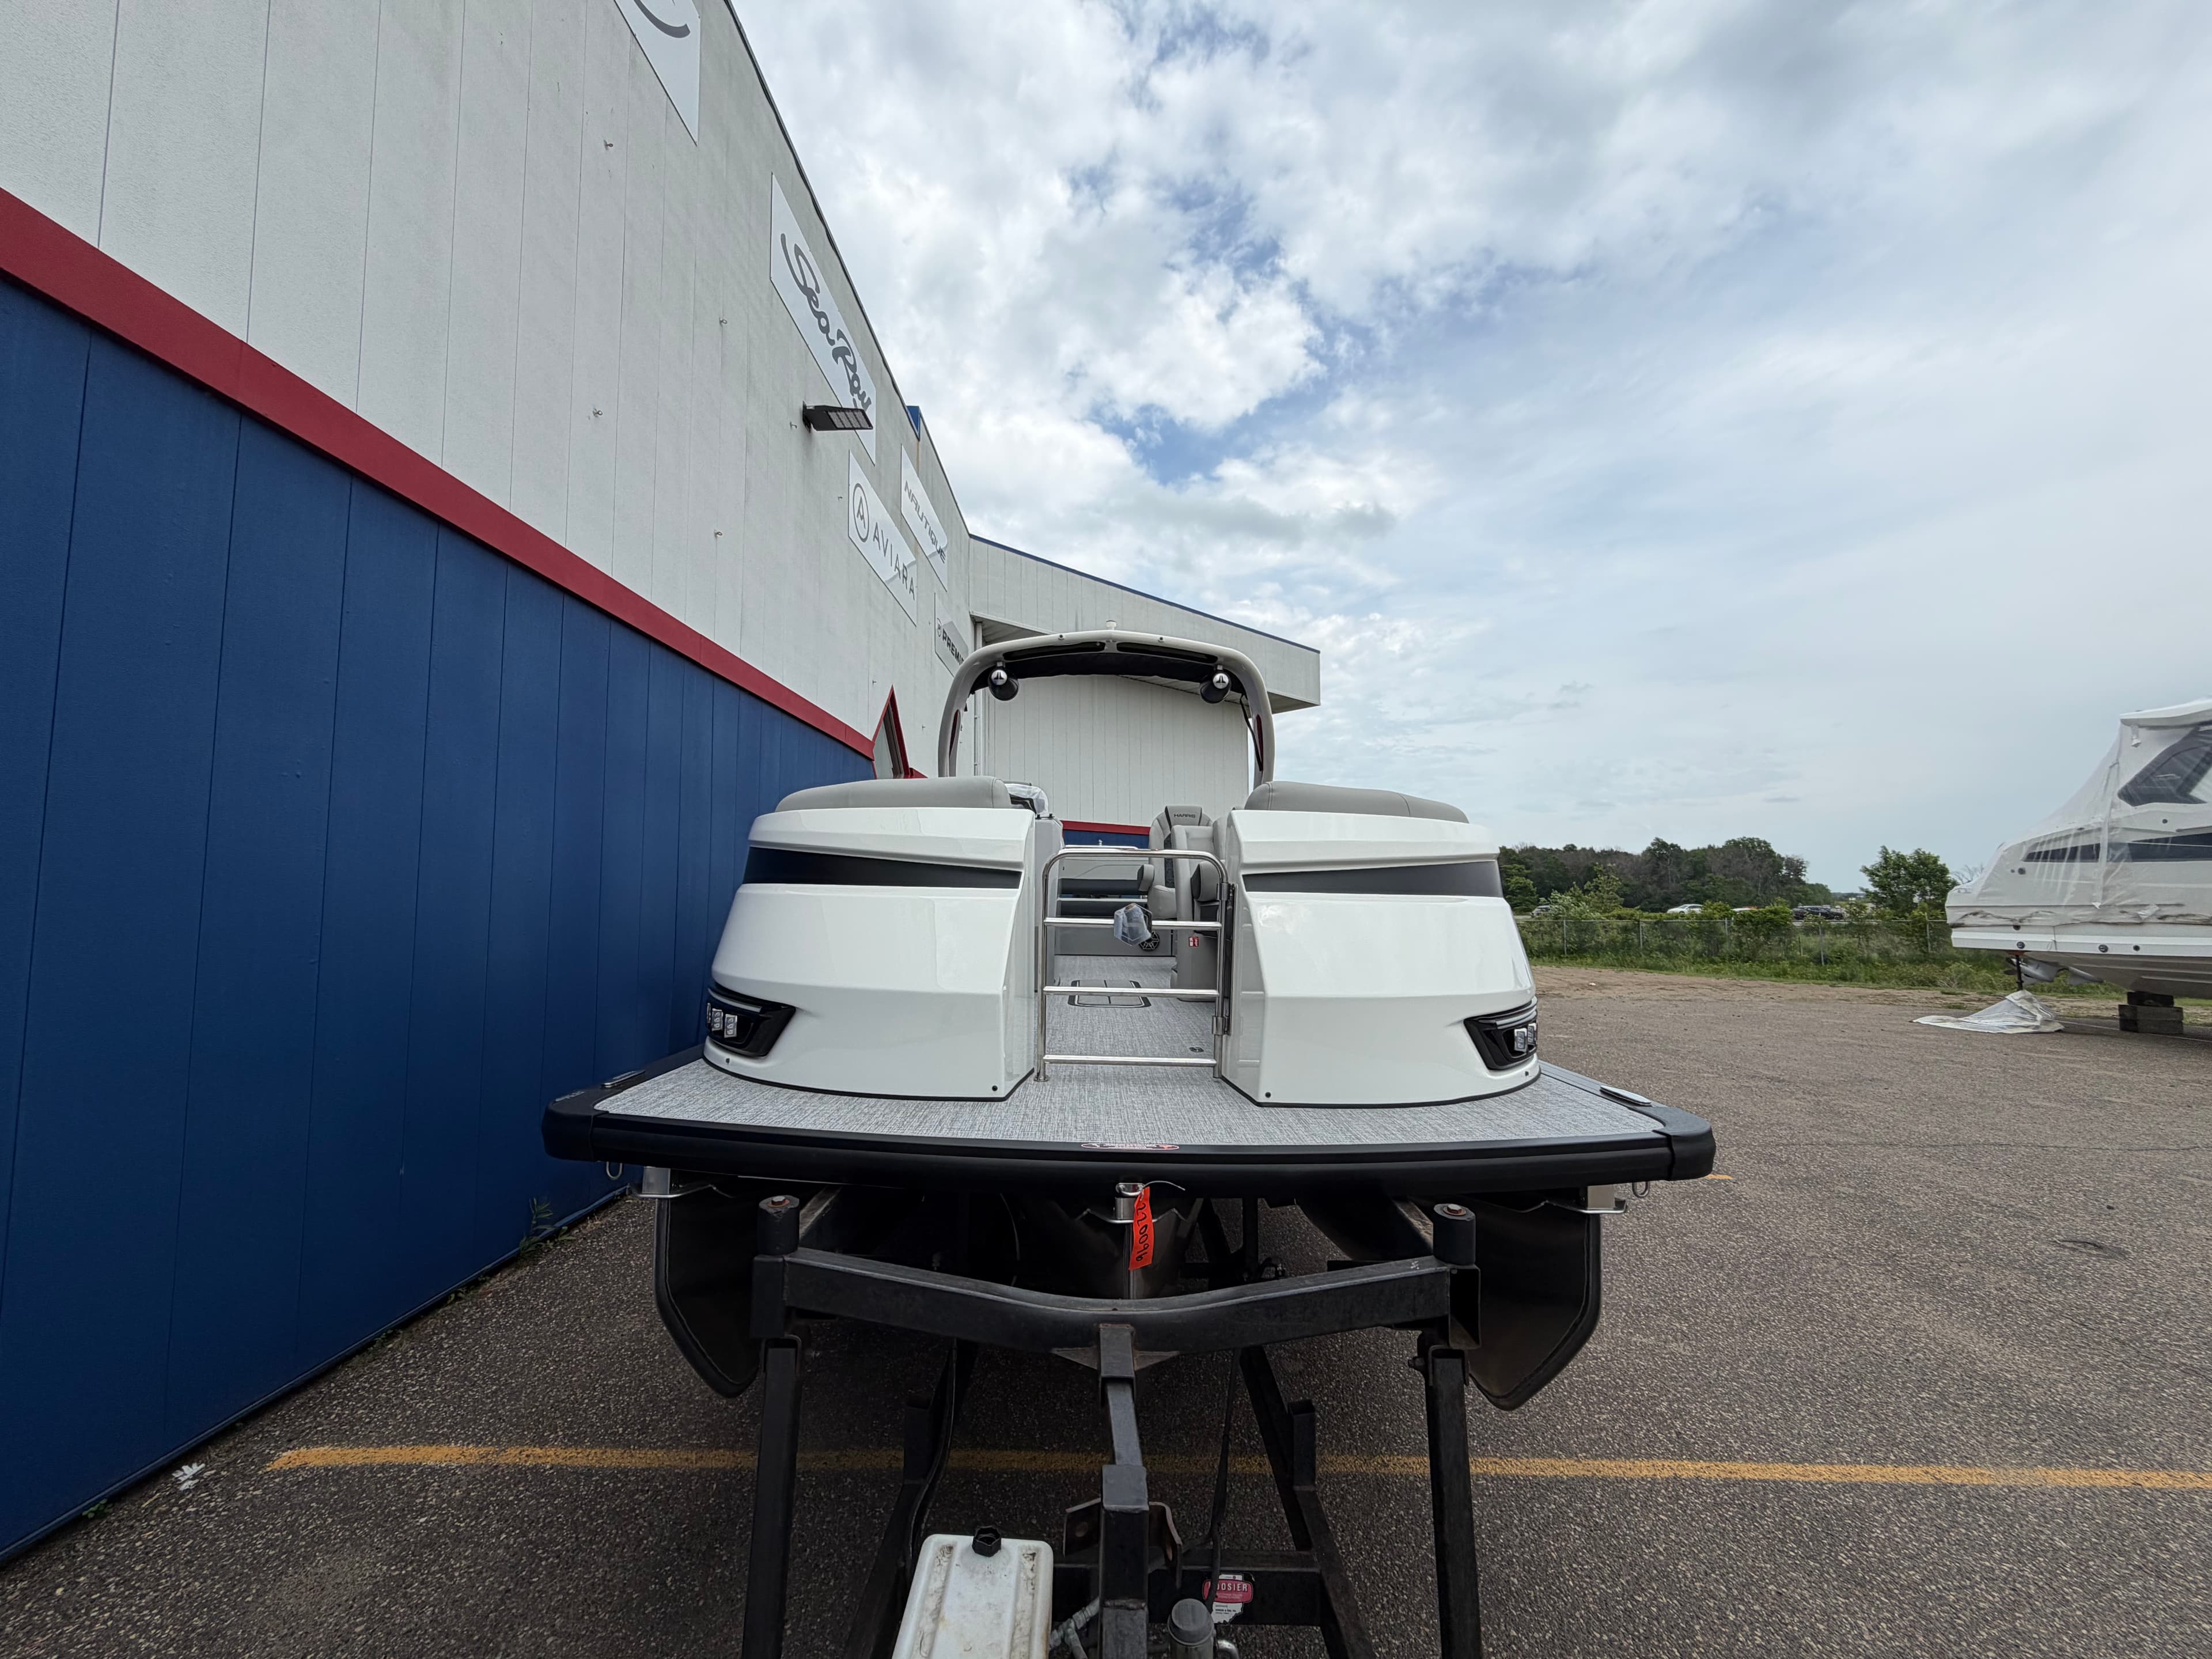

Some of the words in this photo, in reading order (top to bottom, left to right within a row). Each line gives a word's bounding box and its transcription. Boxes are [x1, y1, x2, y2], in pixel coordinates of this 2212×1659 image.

[781, 233, 835, 346] Sea
[873, 522, 915, 600] AVIARA
[904, 480, 946, 564] NAUTIQUE
